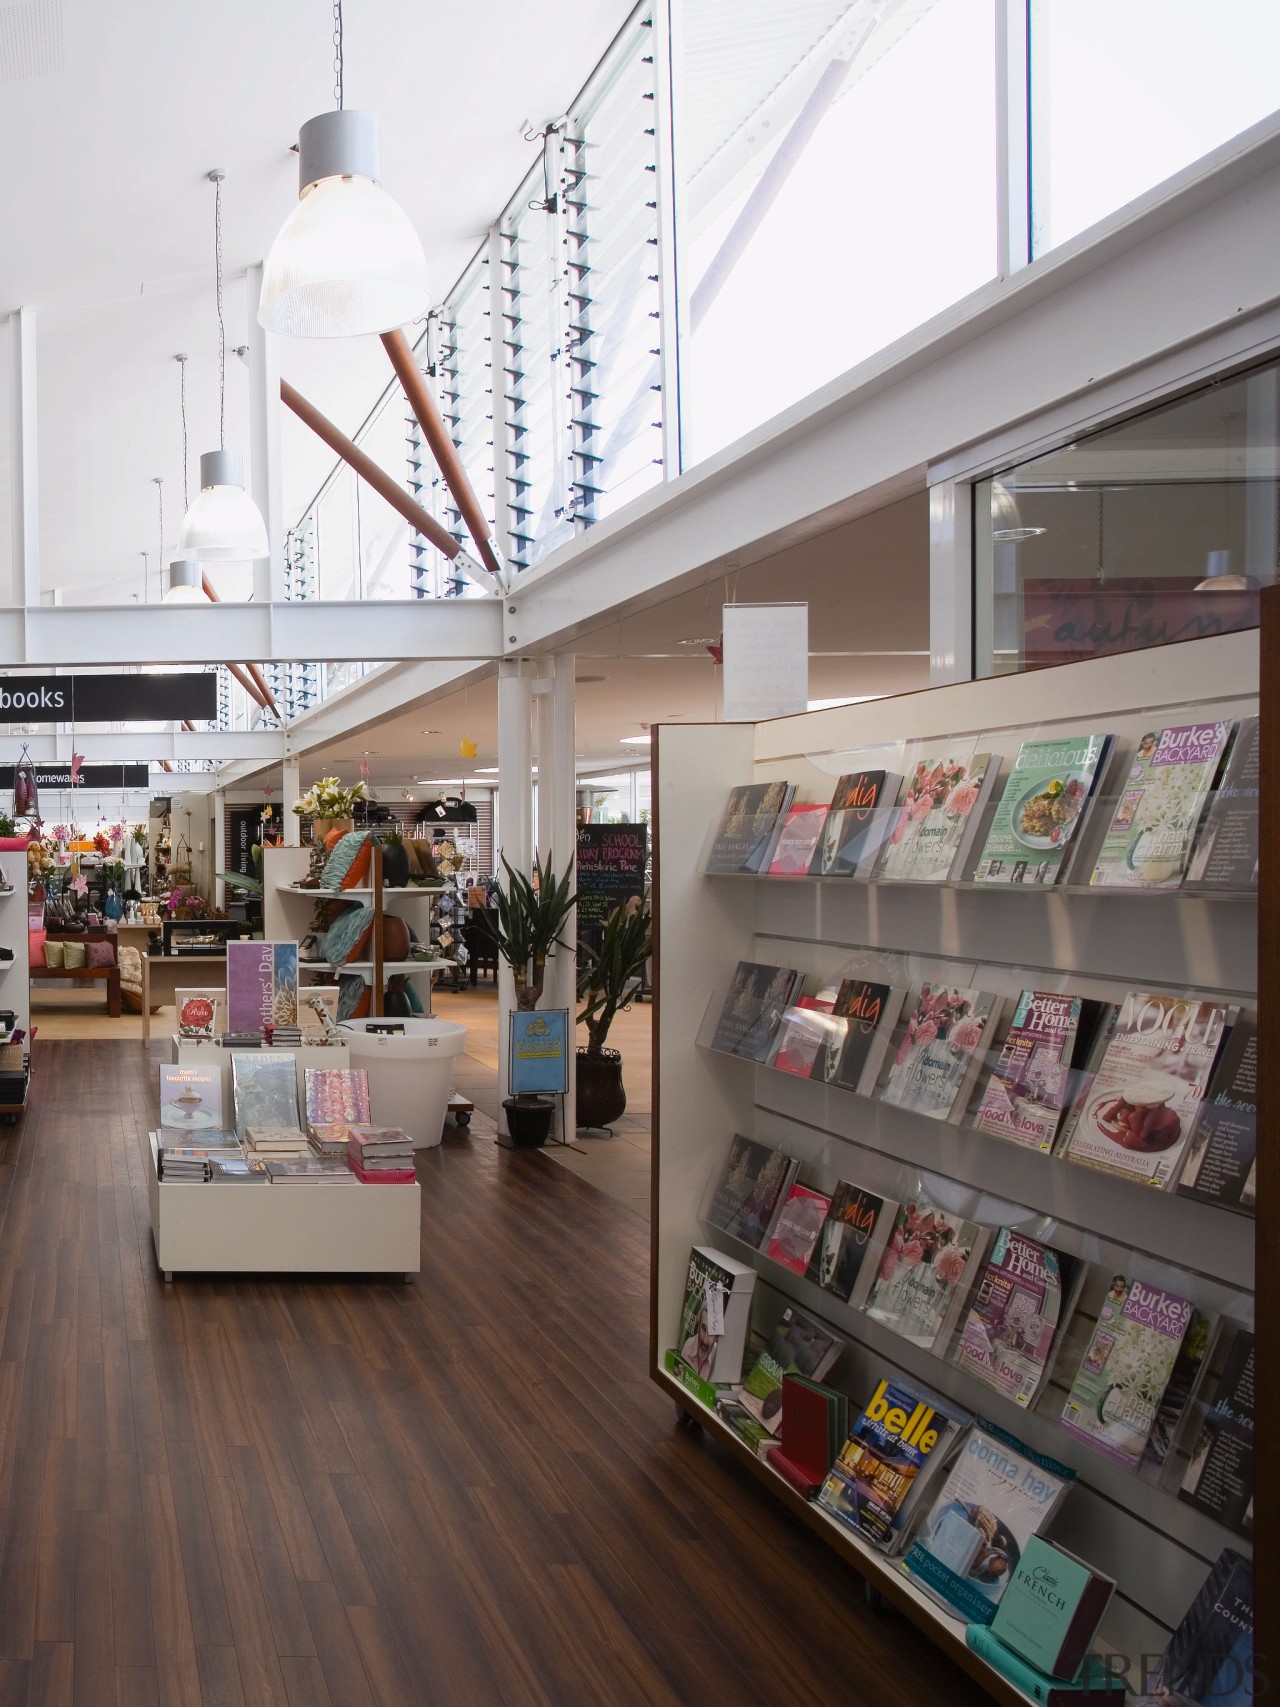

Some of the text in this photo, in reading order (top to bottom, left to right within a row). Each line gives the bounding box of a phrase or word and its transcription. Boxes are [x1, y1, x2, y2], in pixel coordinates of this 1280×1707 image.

[0, 687, 64, 709] books
[1160, 723, 1224, 749] Burke's
[1016, 747, 1099, 769] delicious.
[1153, 744, 1217, 763] BACKYARD
[36, 773, 85, 784] omewaes
[846, 775, 877, 821] dig
[602, 834, 642, 847] SCHOOL
[921, 825, 948, 838] domain
[603, 848, 645, 861] PROGRAM
[904, 839, 946, 856] flowers
[239, 853, 247, 873] living
[577, 860, 638, 872] Prehistoric Pine
[259, 946, 273, 1026] others' Day
[849, 984, 880, 1034] dig
[1018, 991, 1068, 1015] Better
[1028, 1012, 1078, 1032] Homes
[1126, 997, 1226, 1047] VOGUE
[517, 1041, 561, 1053] EASTER
[1115, 1032, 1180, 1053] ENTERTAINING
[1185, 1045, 1217, 1059] TRAVEL
[907, 1063, 947, 1090] flowers
[923, 1056, 950, 1071] domain
[1215, 1087, 1232, 1110] the
[981, 1105, 1005, 1122] food
[1021, 1115, 1045, 1134] love
[1072, 1139, 1113, 1159] CELEBRATING
[1113, 1151, 1149, 1168] AUSTRALIA
[845, 1193, 874, 1245] dig
[999, 1228, 1040, 1262] Better
[1008, 1254, 1059, 1285] Homes
[1022, 1272, 1033, 1282] and
[891, 1283, 933, 1316] flowers
[908, 1278, 936, 1298] domain
[1128, 1281, 1191, 1323] Burke's
[1123, 1299, 1185, 1339] BACKYARD
[962, 1341, 985, 1361] food
[999, 1361, 1023, 1384] love
[865, 1379, 939, 1454] belle
[1215, 1397, 1233, 1419] the
[862, 1417, 919, 1457] Artists at home
[969, 1439, 1057, 1505] donna hay
[911, 1545, 926, 1563] FREE
[922, 1556, 951, 1584] pocket
[950, 1578, 994, 1616] organiser
[1017, 1570, 1067, 1611] FRENCH
[1032, 1566, 1061, 1589] Classic
